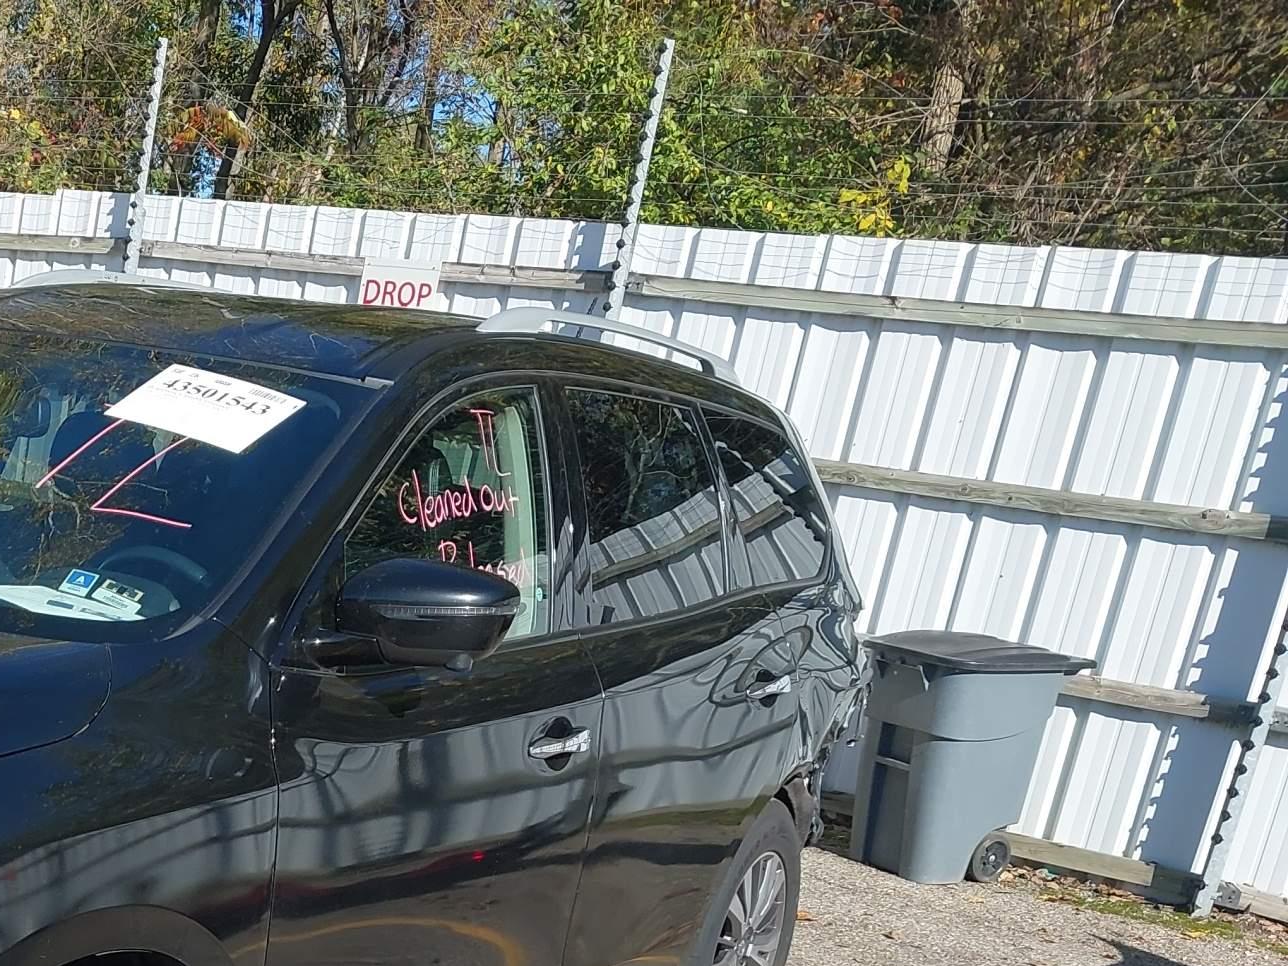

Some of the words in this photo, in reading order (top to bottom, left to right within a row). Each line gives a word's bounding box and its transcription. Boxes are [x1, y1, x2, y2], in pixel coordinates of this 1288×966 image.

[362, 279, 432, 307] DROP
[162, 379, 271, 415] 43501543
[399, 468, 479, 532] Cleaned
